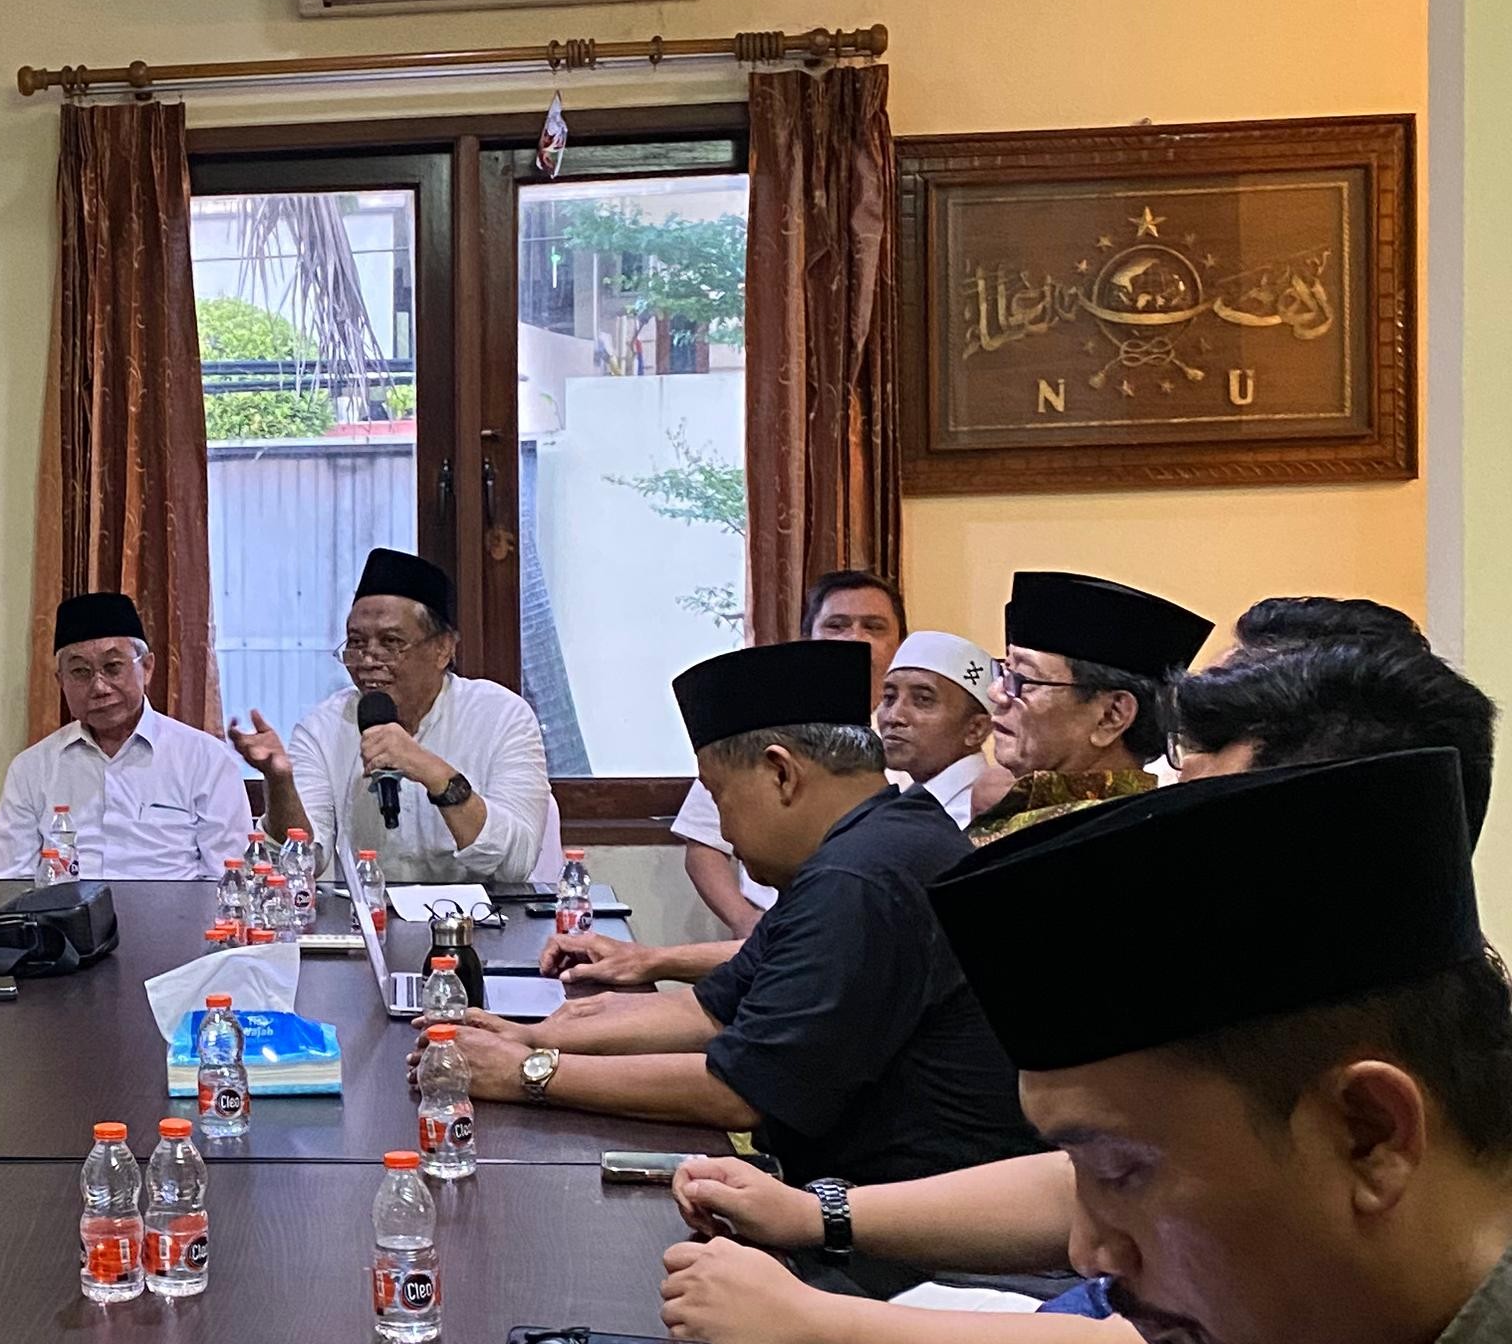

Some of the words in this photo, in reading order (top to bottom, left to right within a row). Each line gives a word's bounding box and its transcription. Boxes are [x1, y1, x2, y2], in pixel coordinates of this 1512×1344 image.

[1037, 379, 1066, 413] N
[1229, 369, 1256, 406] U
[407, 1282, 433, 1301] Cleo
